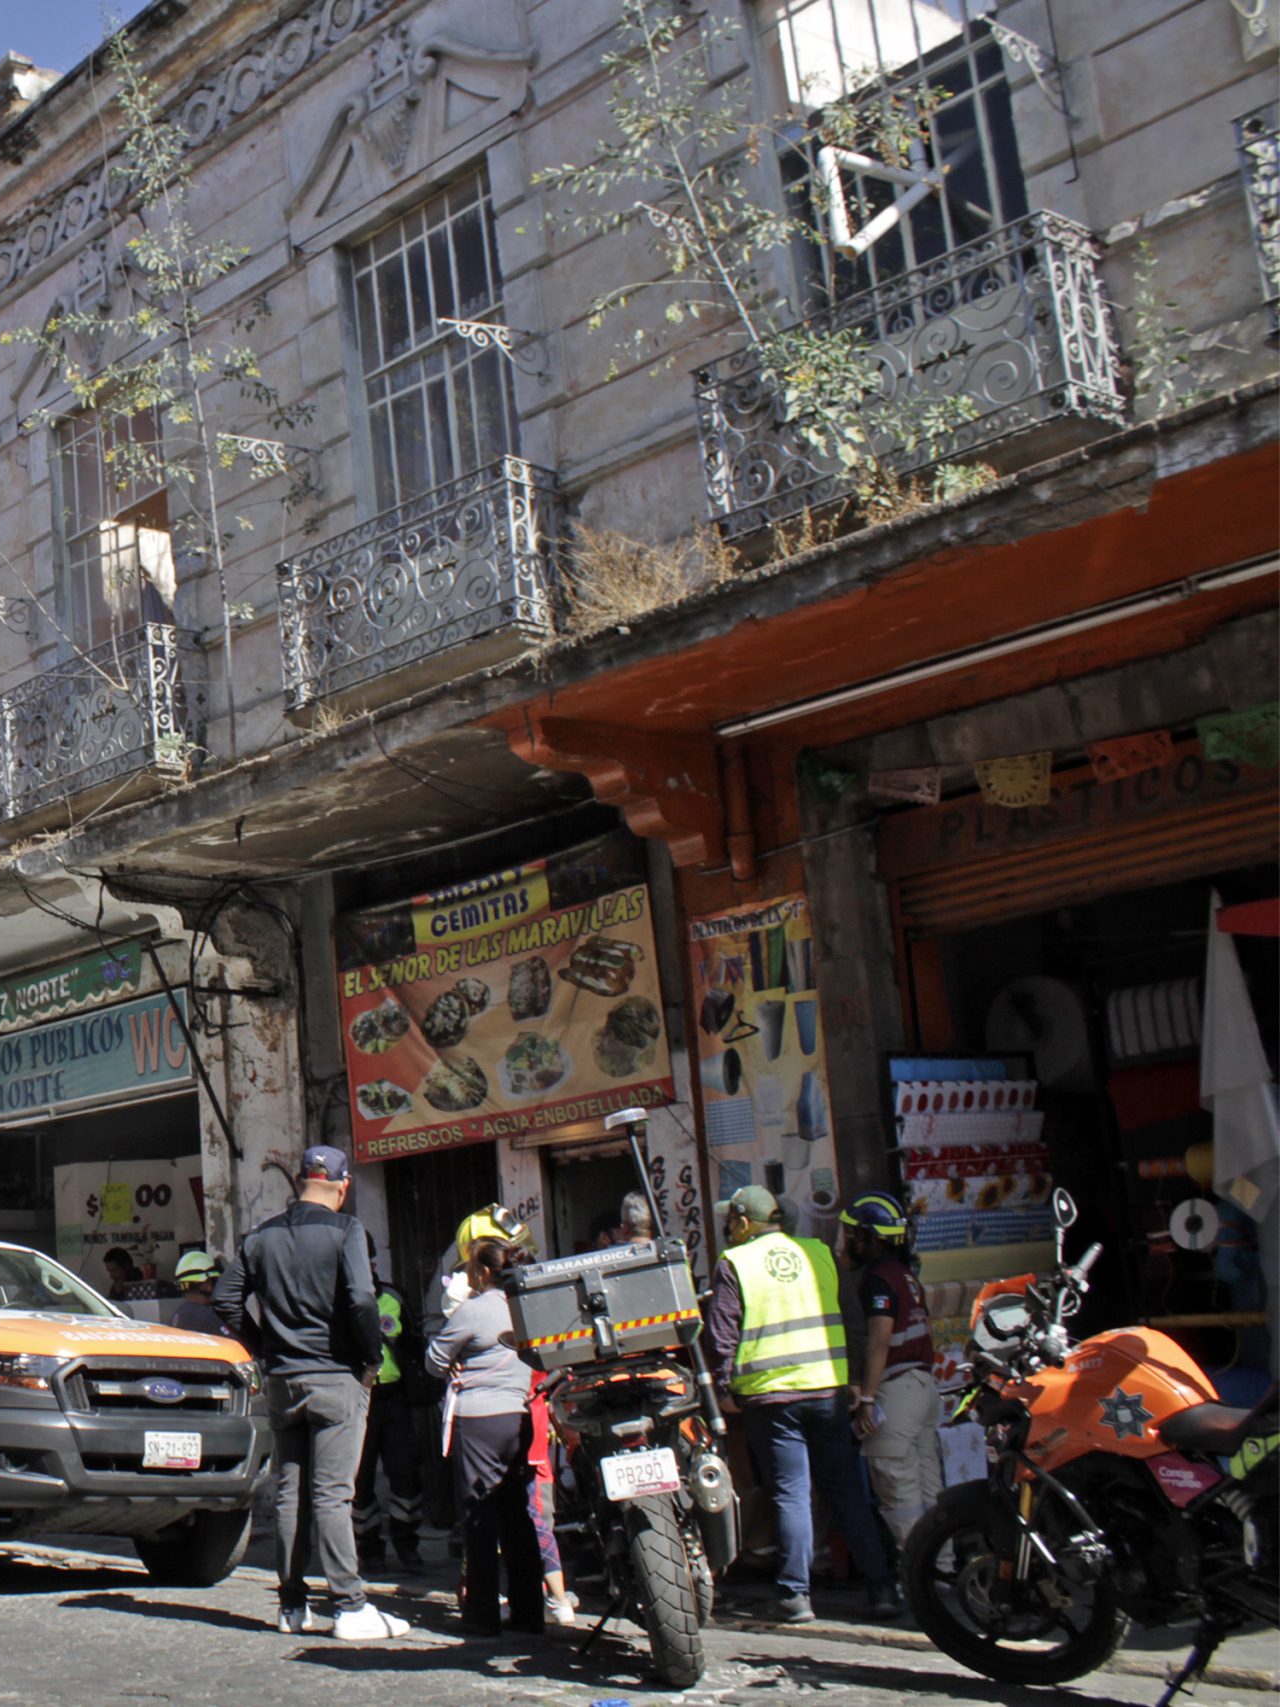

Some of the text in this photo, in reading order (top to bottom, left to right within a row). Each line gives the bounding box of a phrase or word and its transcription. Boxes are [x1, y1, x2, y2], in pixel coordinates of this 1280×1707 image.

[431, 889, 528, 937] CEMITAS
[100, 954, 132, 984] WC
[344, 971, 364, 998] EL
[436, 942, 461, 975] DE
[467, 932, 502, 965] LAS
[506, 888, 645, 954] MARAVILLAS
[30, 1011, 124, 1070] PUBLICOS
[128, 1003, 187, 1076] WC
[367, 1126, 464, 1157] REFRESCOS
[483, 1114, 531, 1138] AGUA
